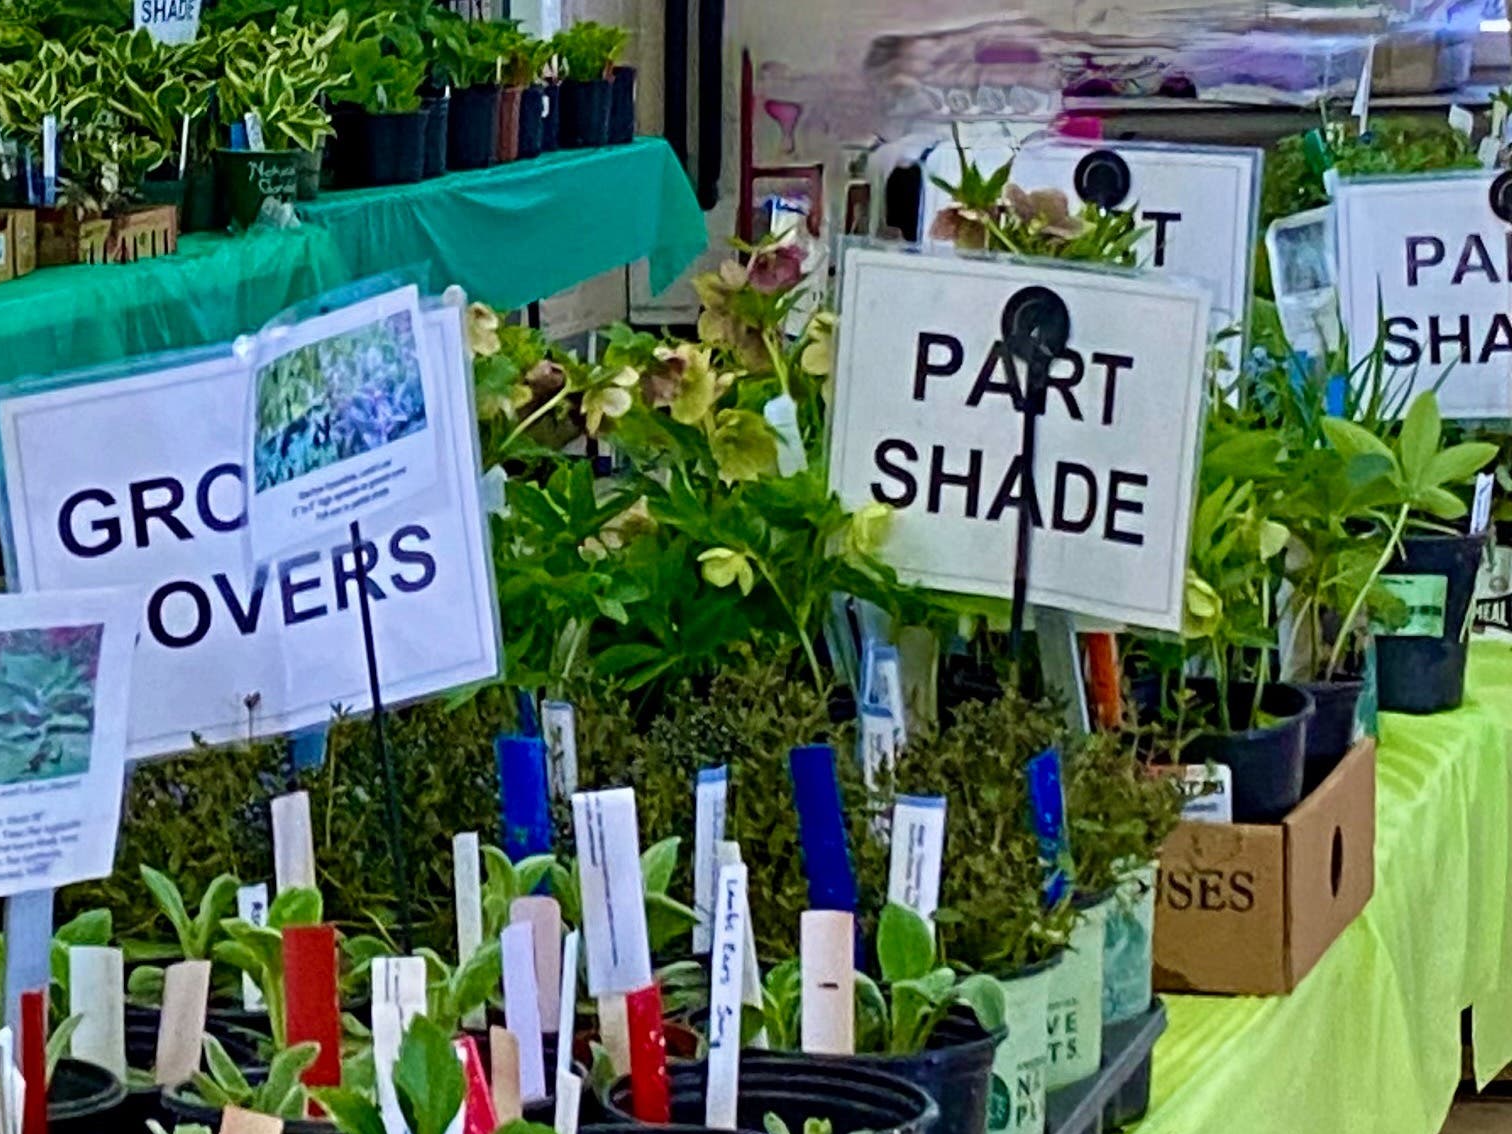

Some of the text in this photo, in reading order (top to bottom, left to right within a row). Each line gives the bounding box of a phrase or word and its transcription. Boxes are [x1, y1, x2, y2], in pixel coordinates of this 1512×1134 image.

[1405, 232, 1512, 288] PA
[913, 332, 1134, 426] PART
[58, 463, 248, 559] GRO
[870, 438, 1148, 546] SHADE
[134, 524, 437, 649] OVERS
[1157, 867, 1255, 912] SES
